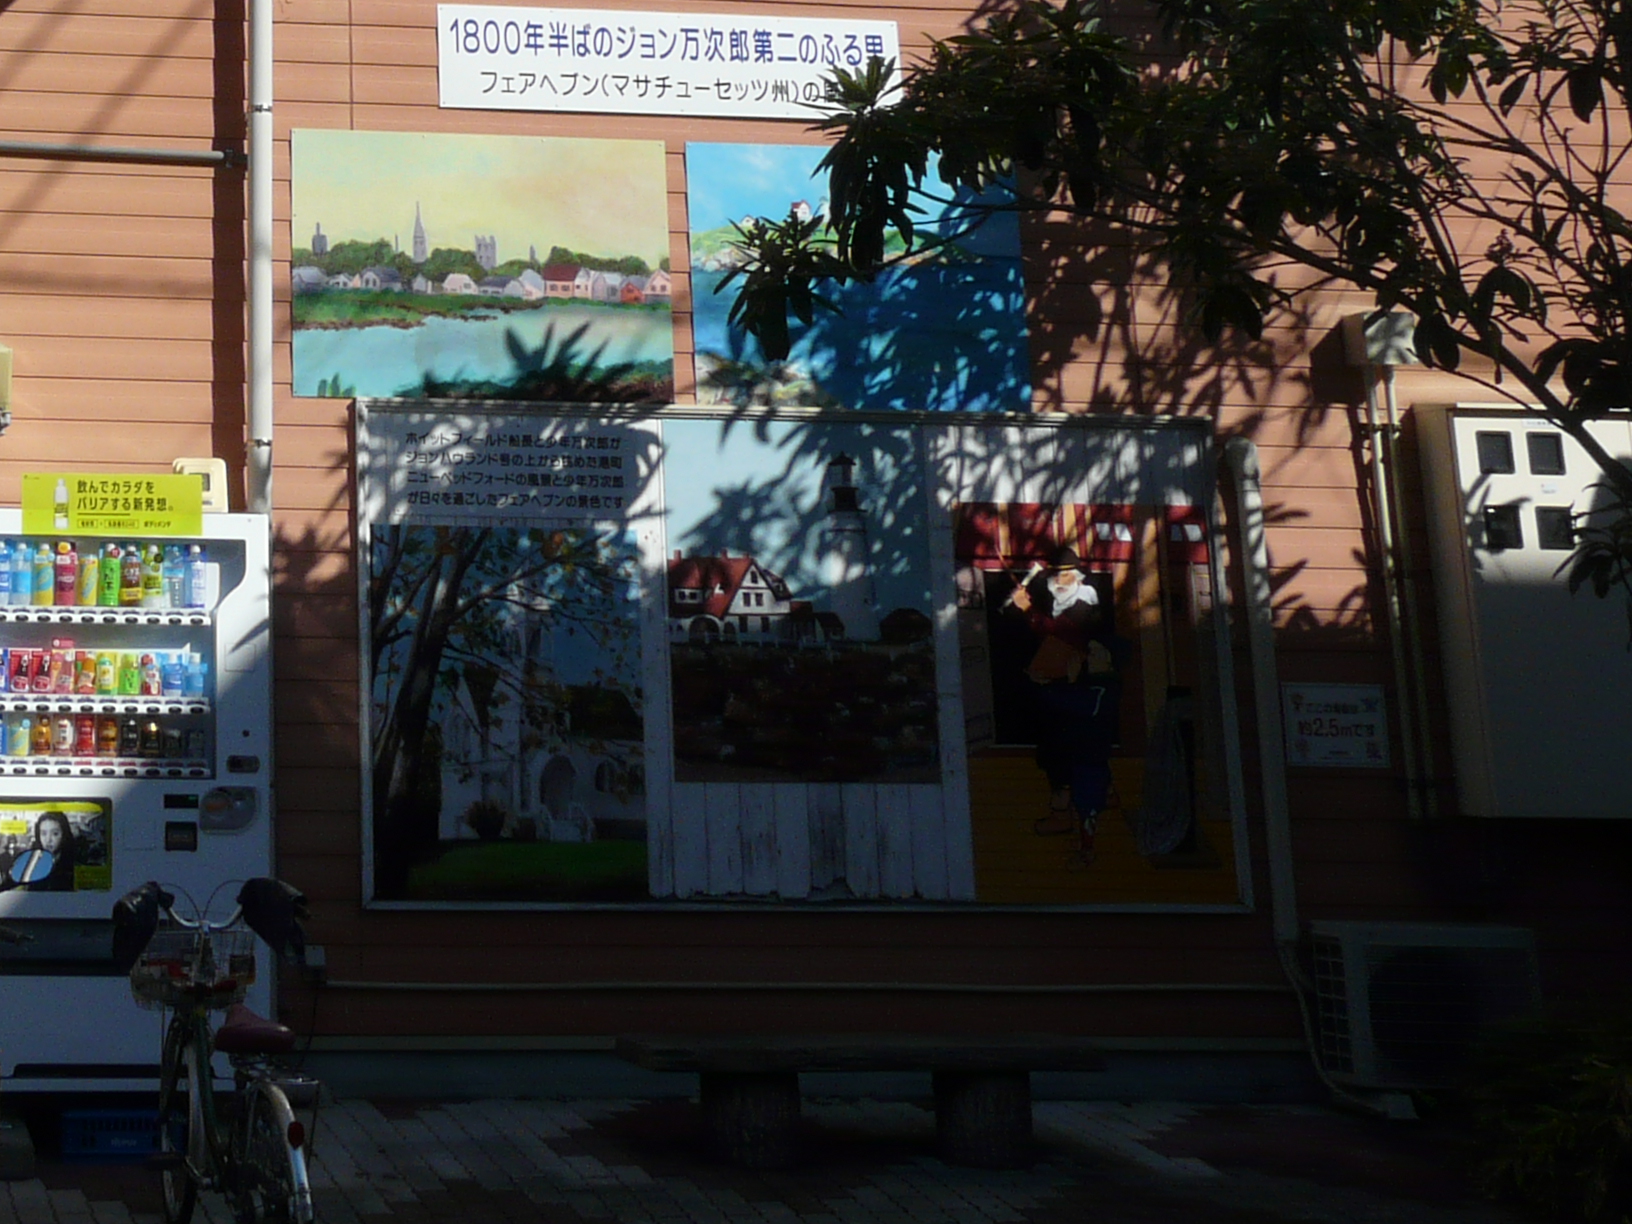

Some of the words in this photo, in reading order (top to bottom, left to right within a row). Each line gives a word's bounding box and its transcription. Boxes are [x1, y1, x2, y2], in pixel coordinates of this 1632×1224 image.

[76, 479, 155, 494] 飲んでカラダを
[76, 497, 174, 512] バリアする新発想。
